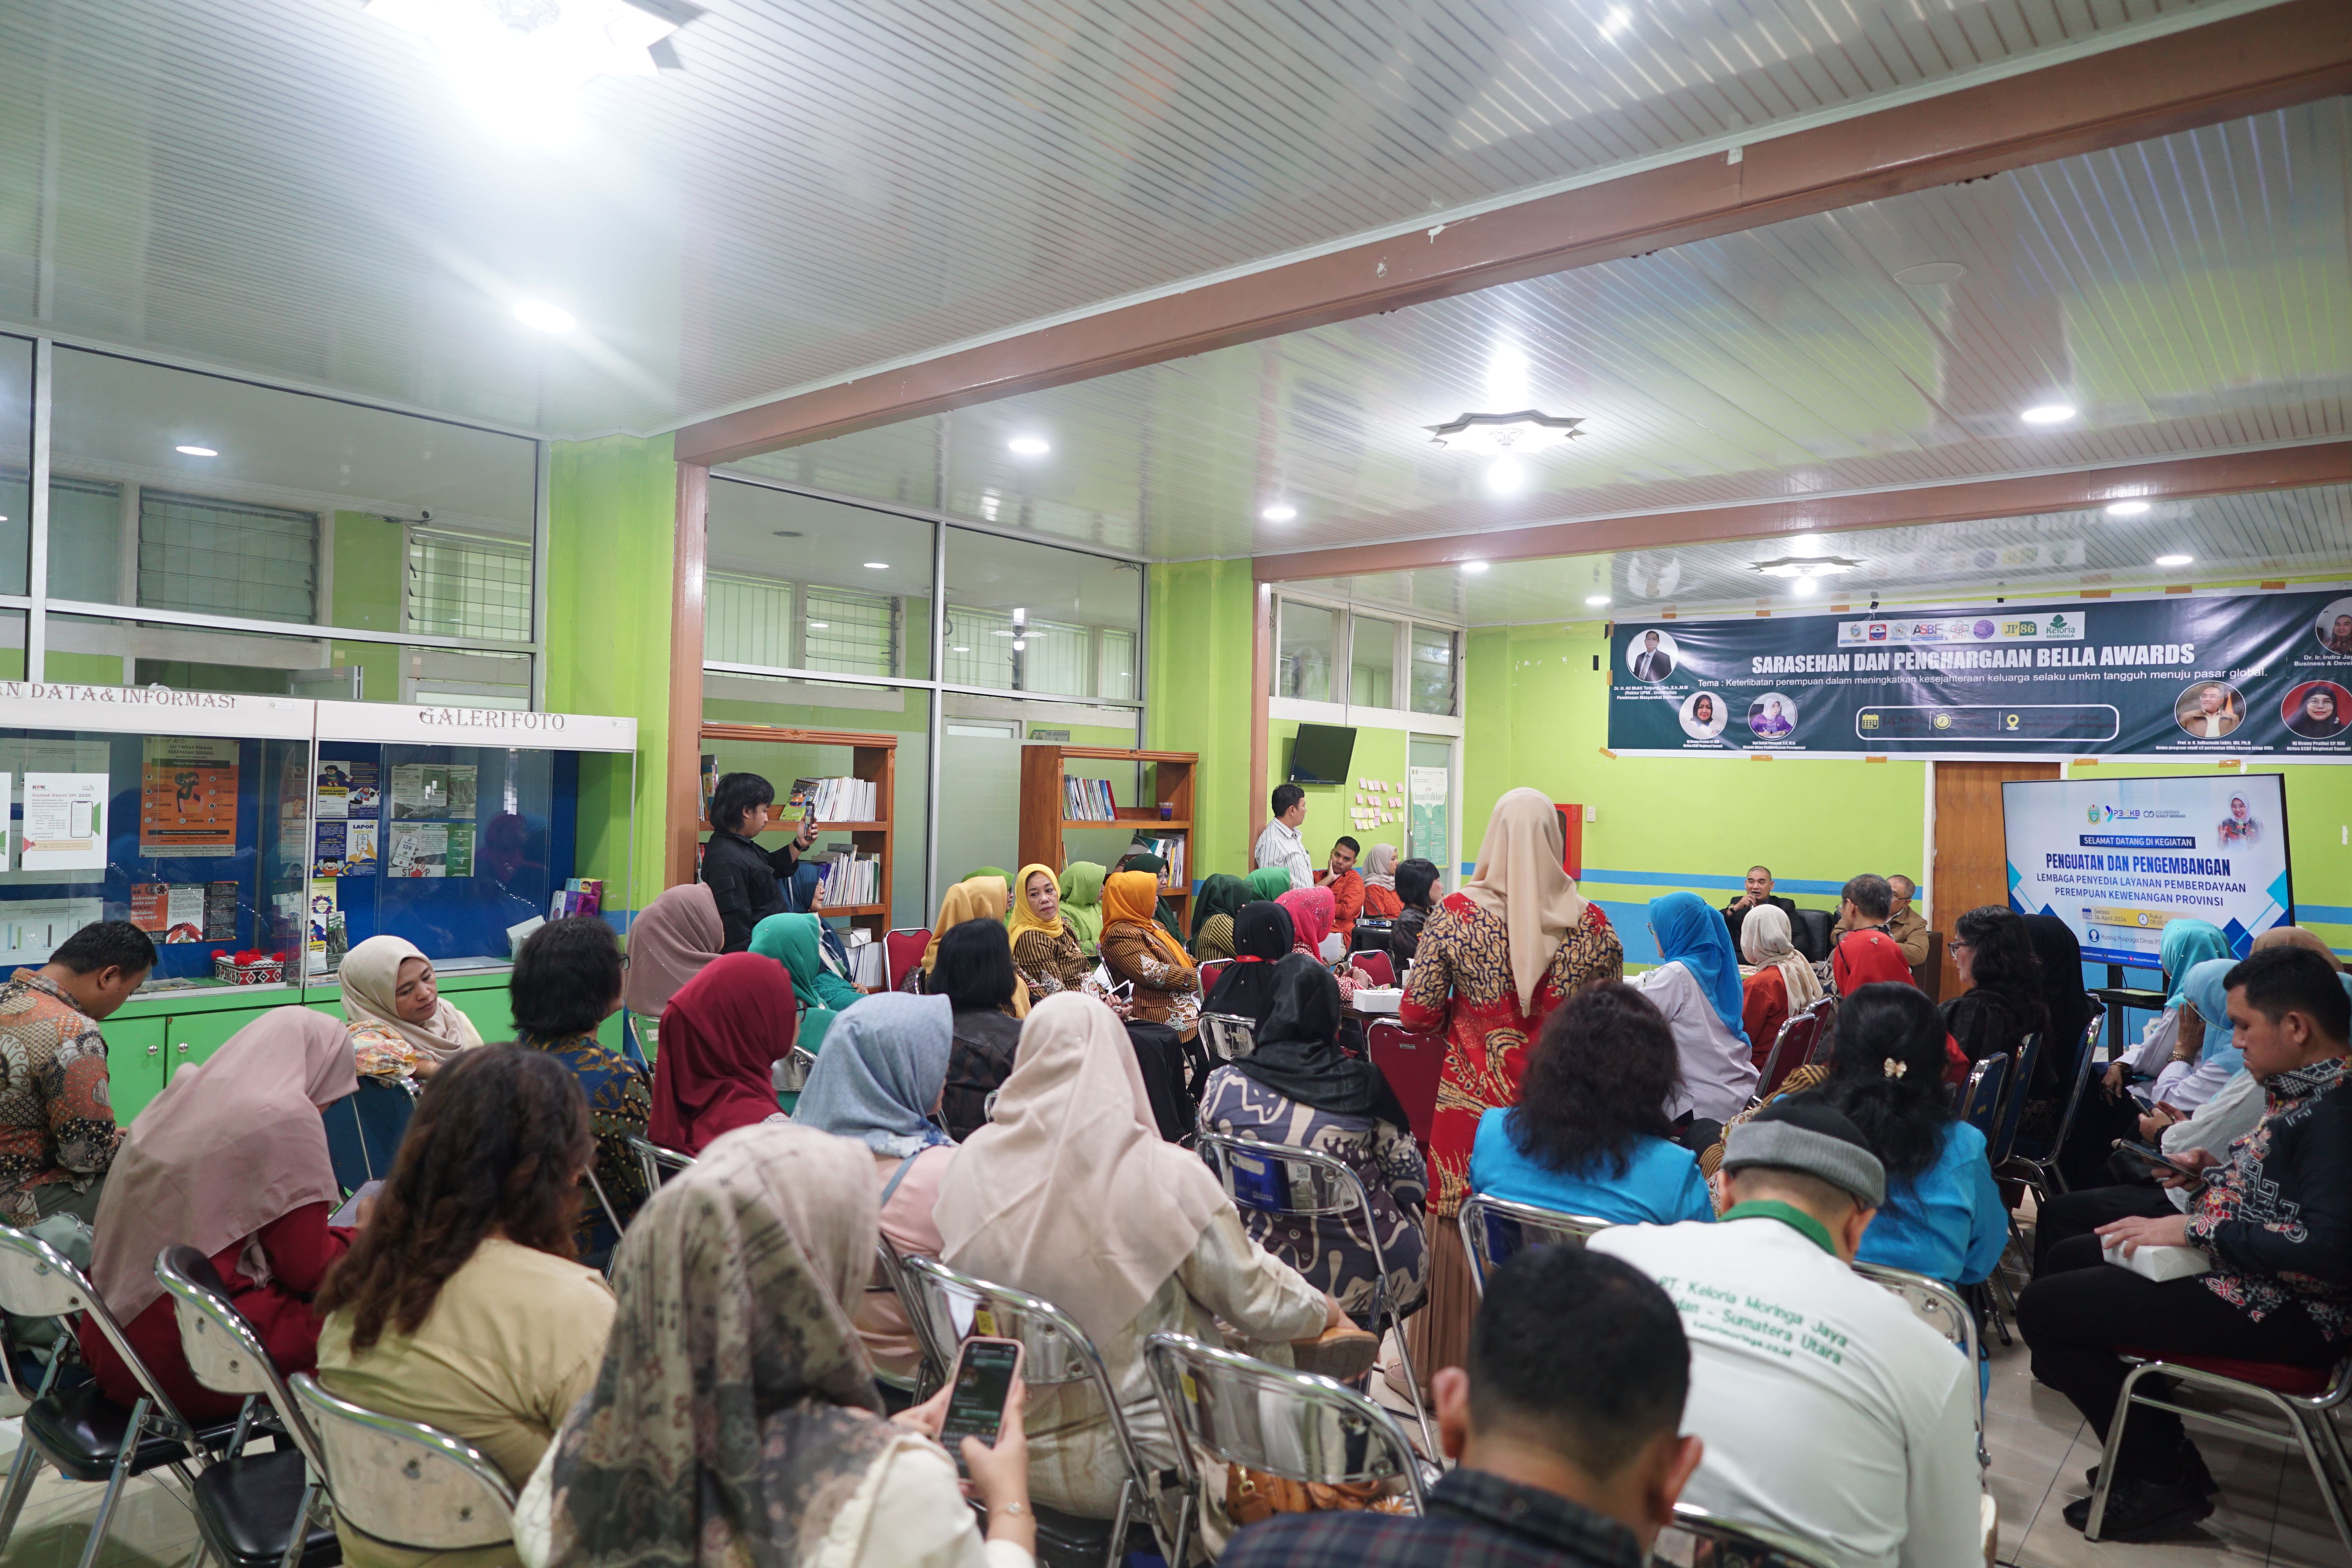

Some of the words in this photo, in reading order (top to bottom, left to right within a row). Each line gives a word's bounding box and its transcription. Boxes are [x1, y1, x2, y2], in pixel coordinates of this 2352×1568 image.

[1913, 624, 1944, 635] ASBF
[2005, 624, 2018, 634] JP
[2020, 624, 2034, 633] 86
[1752, 654, 1849, 674] SARASEHAN
[1854, 653, 1889, 671] DAN
[1894, 649, 2031, 670] PENGHARGAAN
[2037, 647, 2096, 667] BELLA
[2100, 643, 2194, 665] AWARDS
[1726, 678, 1774, 687] Keterlibatan
[1776, 679, 1824, 688] perempuan
[1826, 677, 1852, 685] dalam
[1855, 676, 1917, 686] meningkatkan
[1919, 673, 1985, 684] kesejahteraan
[1988, 673, 2030, 683] keluarga
[2033, 672, 2066, 681] selaku
[2103, 671, 2147, 682] tangguh
[2150, 671, 2190, 681] menuju
[2194, 670, 2227, 681] pasar
[2229, 668, 2267, 679] global.
[31, 683, 96, 700] DATA
[122, 689, 235, 709] INFORMASI
[419, 708, 507, 729] GALERI
[511, 712, 564, 730] FOTO
[2084, 837, 2114, 845] SELAMAT
[2155, 838, 2192, 847] KEGIATAN
[2046, 853, 2104, 871] PENGUATAN
[2107, 855, 2129, 872] DAN
[2133, 856, 2230, 876] PENGEMBANGAN
[2037, 873, 2074, 883] LEMBAGA
[2076, 875, 2118, 885] PENYEDIA
[2120, 877, 2161, 888] LAYANAN
[2165, 880, 2246, 893] PEMBERDAYAAN
[2055, 887, 2106, 898] PEREMPUAN
[2109, 891, 2173, 903] KEWENANGAN
[2176, 895, 2223, 906] PROVINSI
[1687, 1281, 1738, 1305] Keloria
[1745, 1296, 1803, 1325] Moringa
[1811, 1320, 1848, 1348] Jaya
[1675, 1298, 1700, 1313] dan
[1722, 1308, 1792, 1342] Sumatera
[1801, 1334, 1841, 1365] Utara
